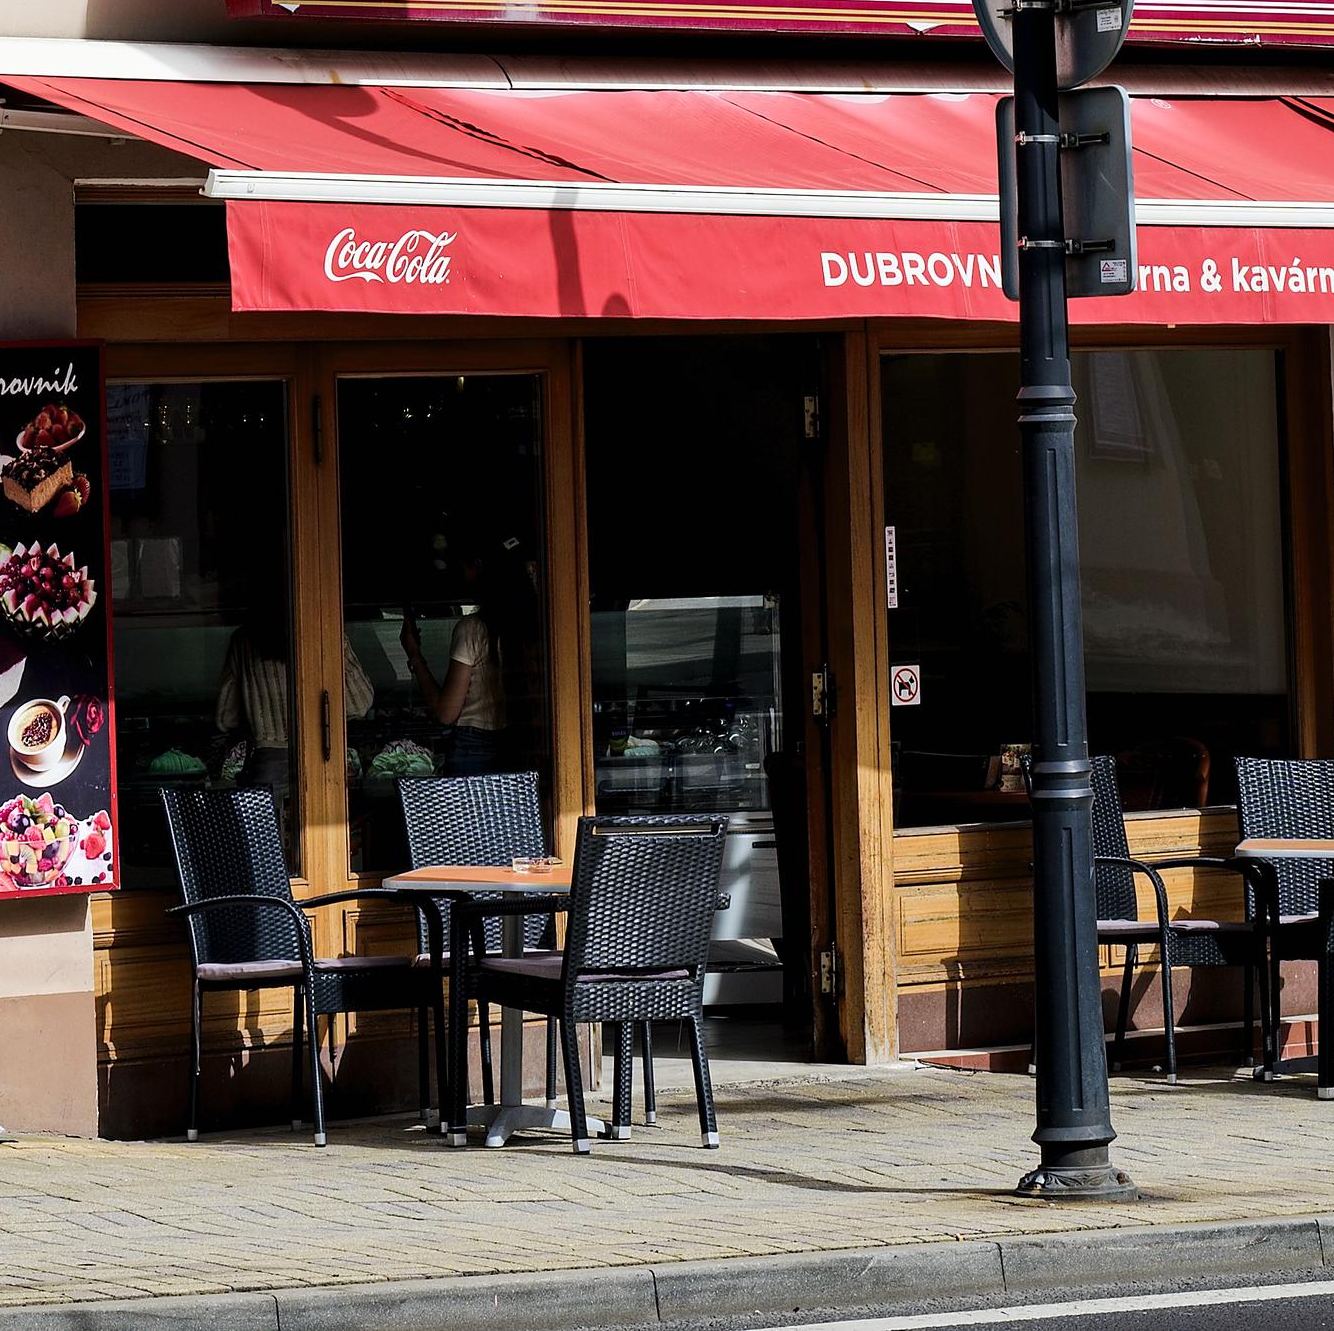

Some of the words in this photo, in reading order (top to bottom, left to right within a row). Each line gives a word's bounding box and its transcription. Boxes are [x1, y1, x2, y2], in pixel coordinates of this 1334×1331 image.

[323, 227, 458, 284] Coca-Cola
[820, 252, 1003, 288] DUBROVN
[1200, 257, 1223, 292] &
